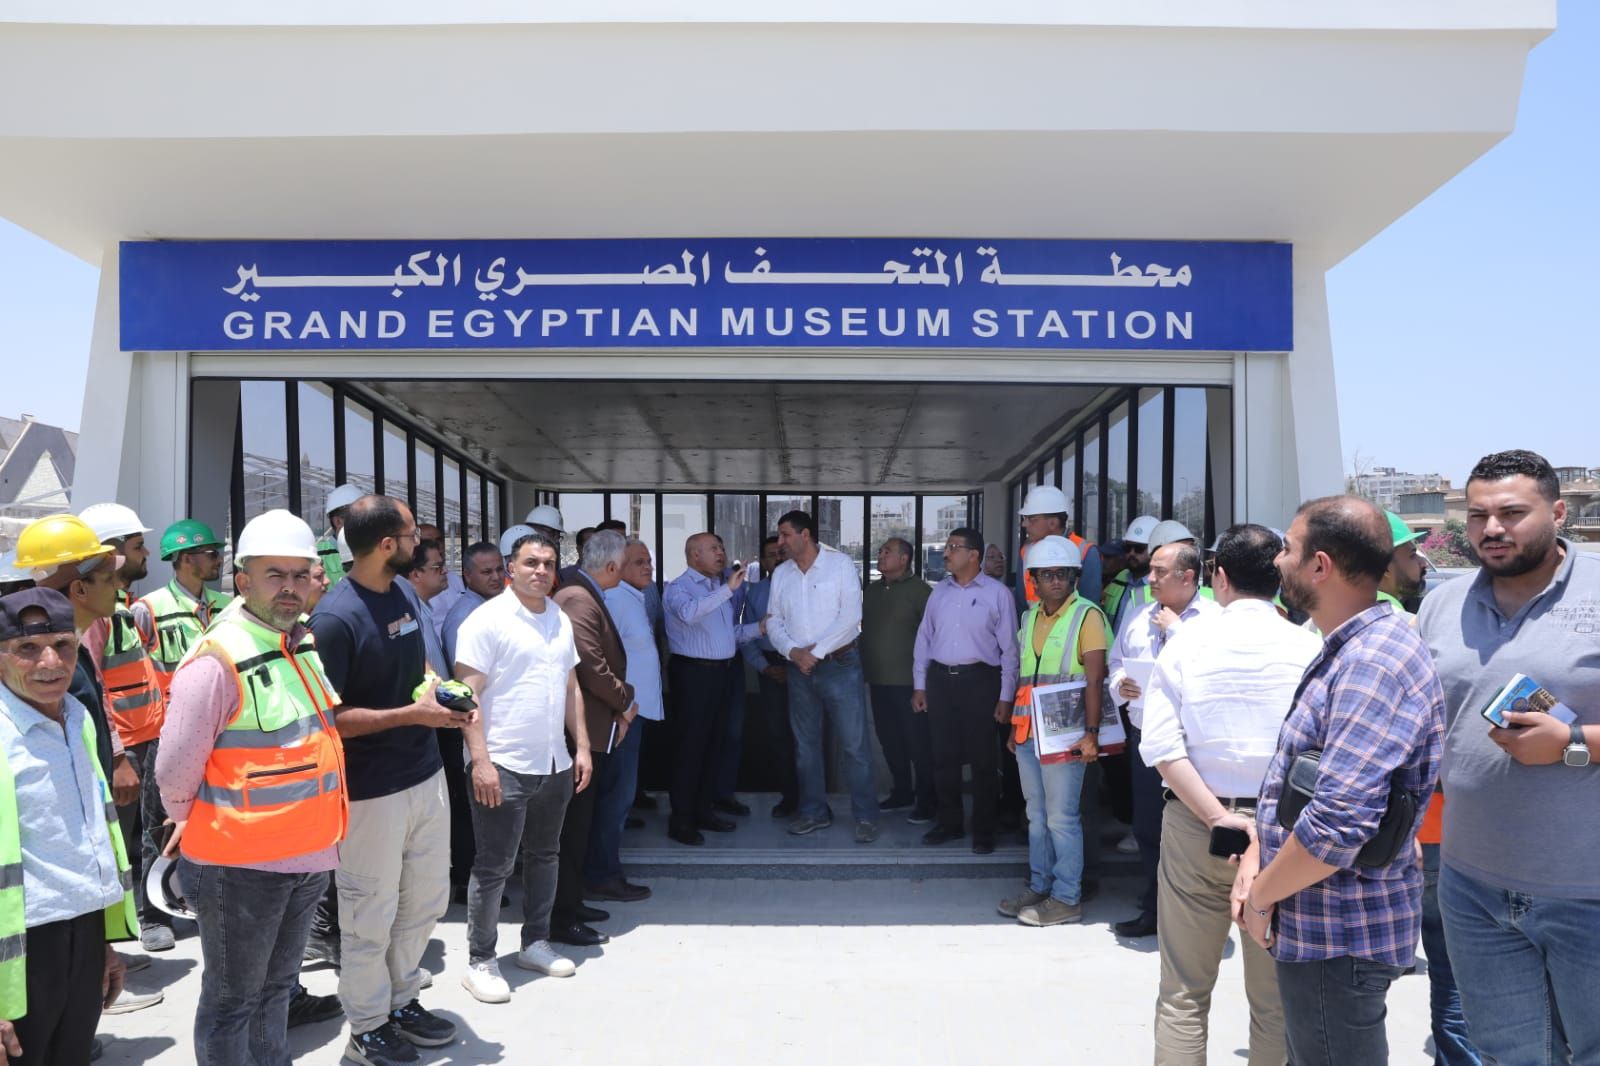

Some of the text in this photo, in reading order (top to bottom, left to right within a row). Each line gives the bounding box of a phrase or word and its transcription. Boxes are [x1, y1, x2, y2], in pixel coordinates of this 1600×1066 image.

[223, 246, 1192, 302] محطة المتحف المصري الكبير
[223, 307, 1192, 340] GRAND EGYPTIAN MUSEUM STATION
